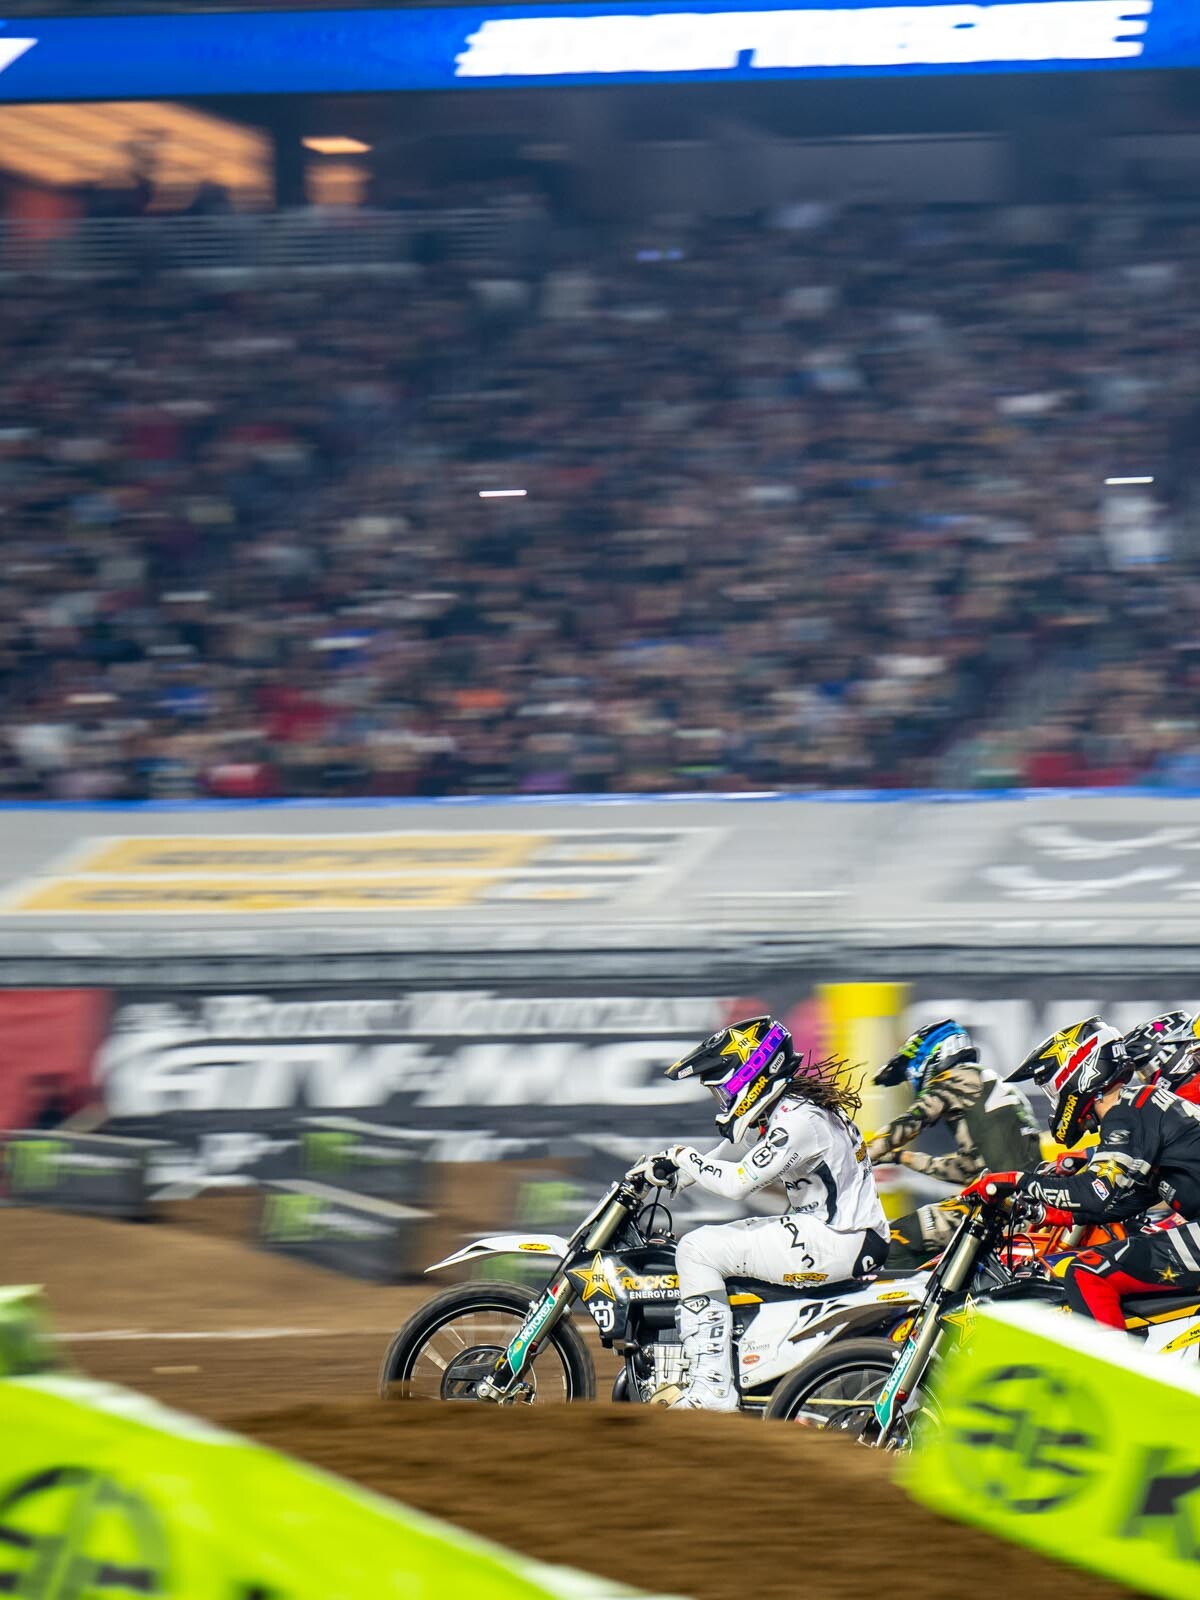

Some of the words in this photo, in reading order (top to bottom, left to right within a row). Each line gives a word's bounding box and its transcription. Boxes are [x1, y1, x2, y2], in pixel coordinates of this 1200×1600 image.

[726, 1025, 784, 1095] SCOTT
[734, 1075, 769, 1117] ROCKSTAR
[1055, 1095, 1078, 1139] ROCKSTAR
[629, 1292, 666, 1300] ENERGY
[520, 1301, 554, 1342] MOTOREX
[886, 1345, 917, 1394] MOTOREX
